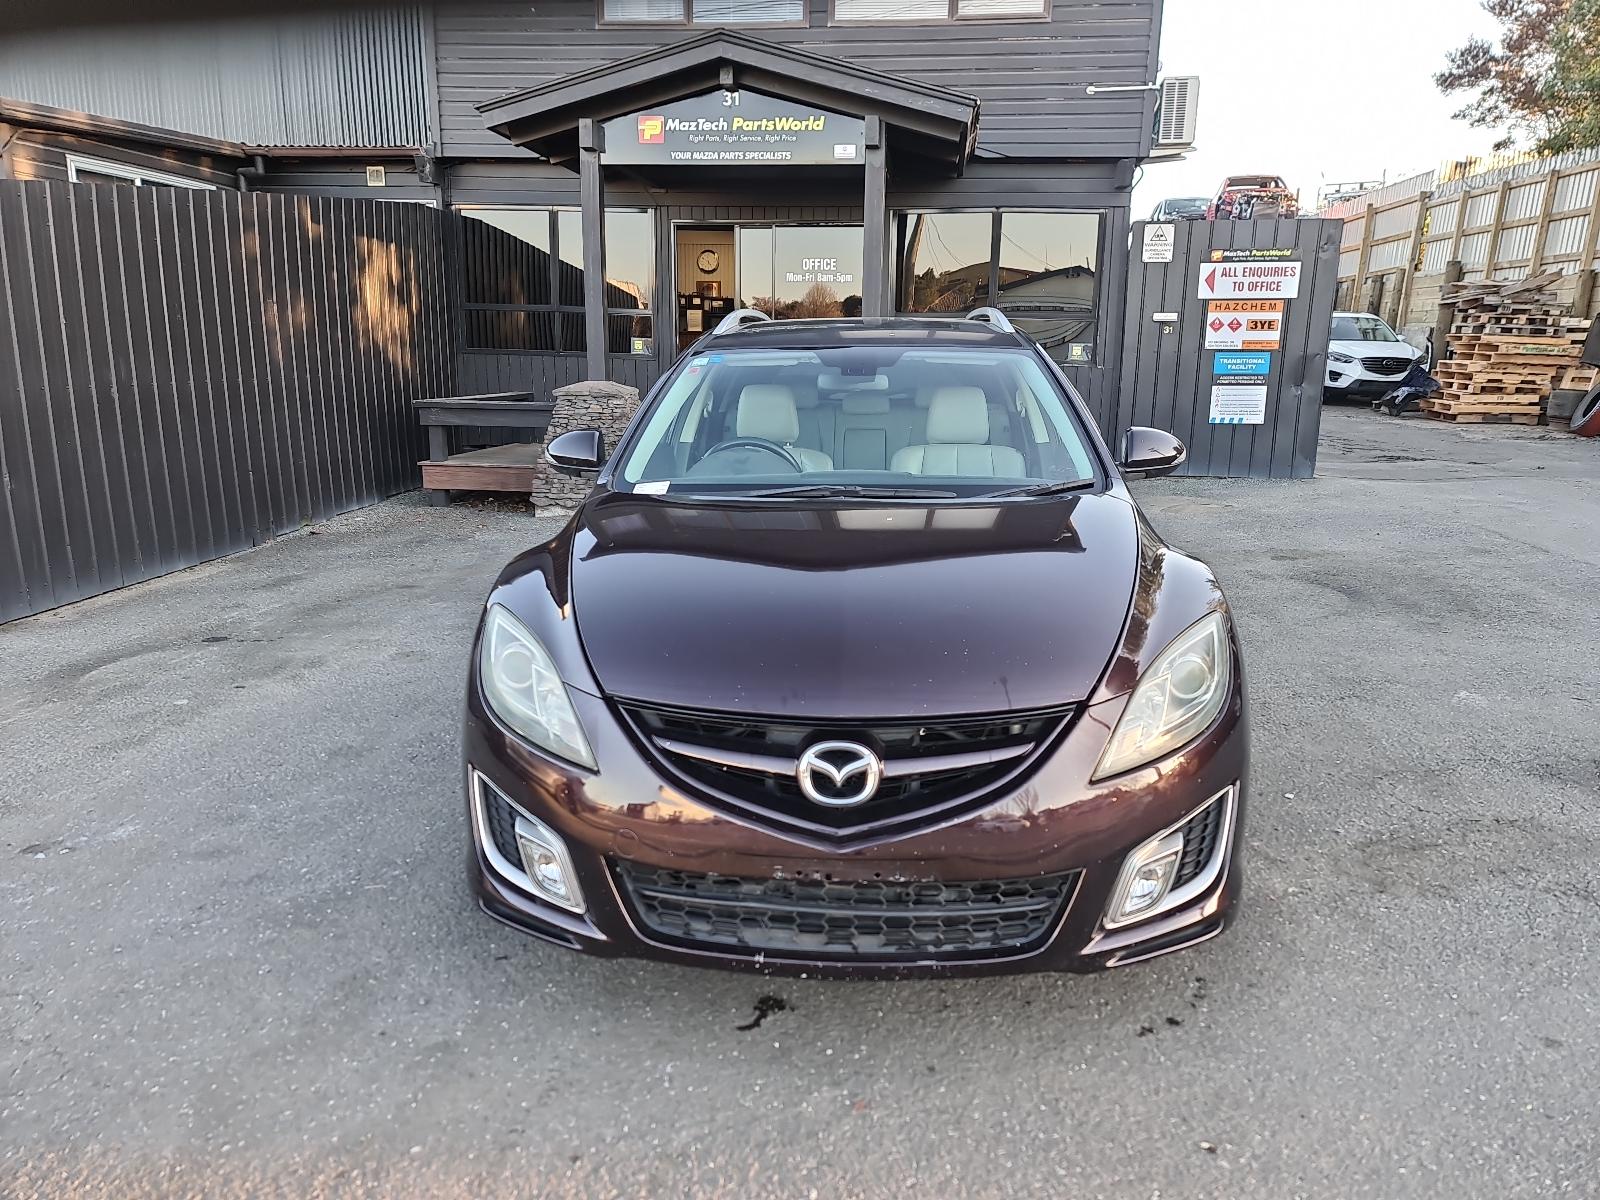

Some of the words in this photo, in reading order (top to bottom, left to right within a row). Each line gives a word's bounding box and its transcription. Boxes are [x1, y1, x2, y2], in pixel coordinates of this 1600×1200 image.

[722, 91, 740, 106] 31
[665, 117, 728, 131] MazTech
[732, 115, 825, 131] PartsWorld
[689, 134, 704, 144] Right
[723, 134, 739, 143] Right
[765, 134, 780, 143] Right
[781, 134, 797, 142] Price
[670, 151, 692, 160] YOUR
[692, 151, 719, 160] MAZDA
[719, 151, 744, 160] PARTS
[744, 151, 792, 160] SPECIALISTS
[1251, 248, 1292, 257] PartsWorld
[802, 258, 837, 271] OFFICE
[1220, 266, 1239, 278] ALL
[1242, 266, 1297, 278] ENQUIRIES
[786, 272, 815, 282] Mon-Fri
[817, 272, 853, 283] 8am-5pm
[1232, 281, 1245, 292] TO
[1247, 281, 1282, 292] OFFICE
[1214, 302, 1277, 311] HAZCHEM
[1163, 325, 1173, 334] 31
[1249, 320, 1276, 330] 3YE
